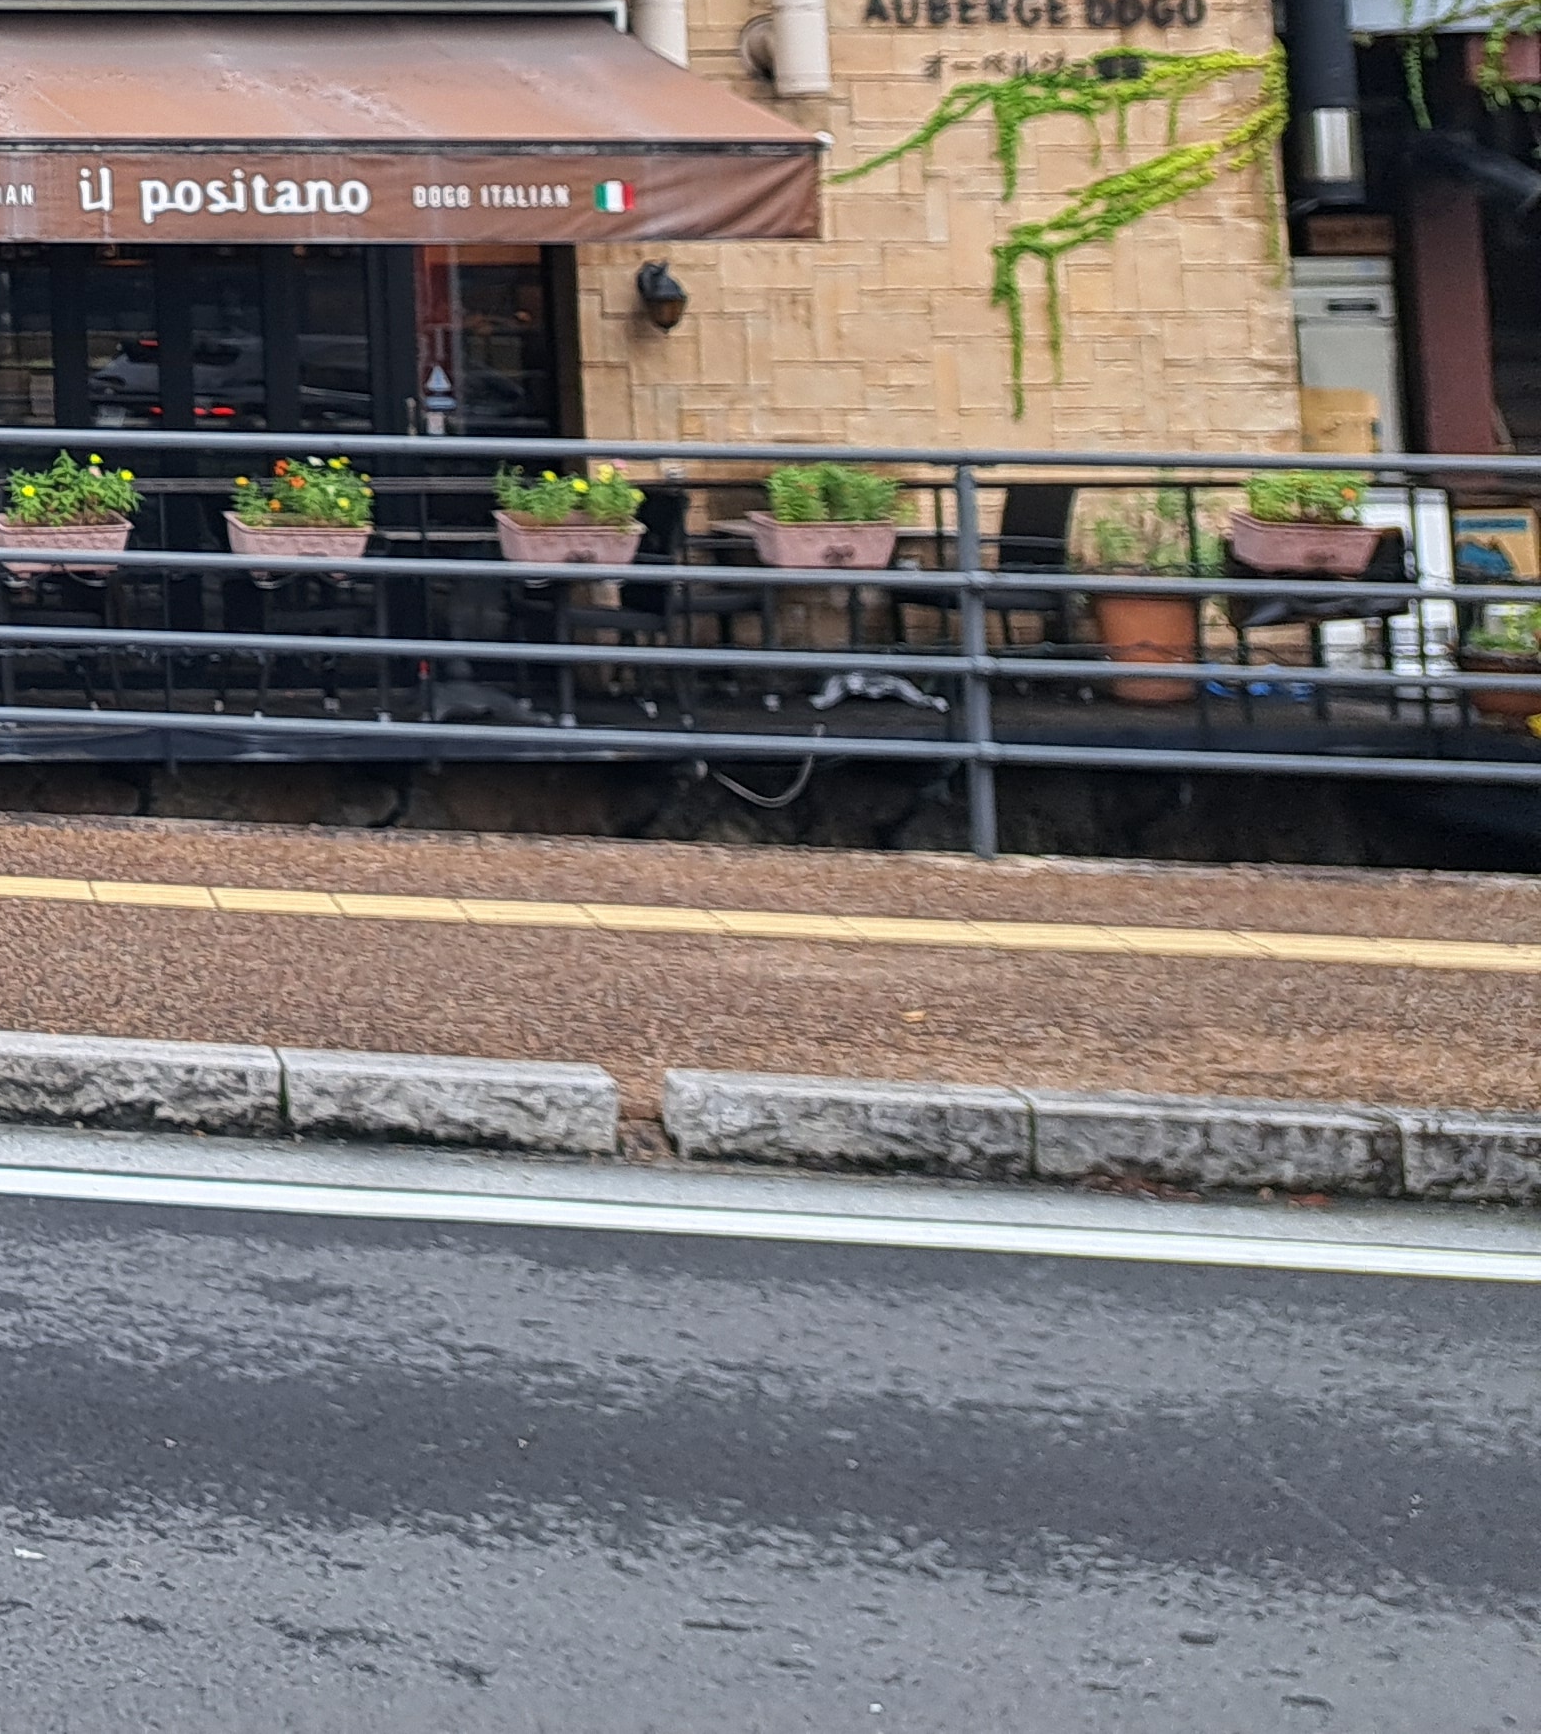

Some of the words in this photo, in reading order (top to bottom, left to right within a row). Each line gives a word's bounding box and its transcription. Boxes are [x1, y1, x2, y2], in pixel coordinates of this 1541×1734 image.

[79, 166, 114, 213] il
[139, 167, 371, 224] positano
[412, 184, 472, 208] DOGO
[479, 184, 571, 208] ITALIAN
